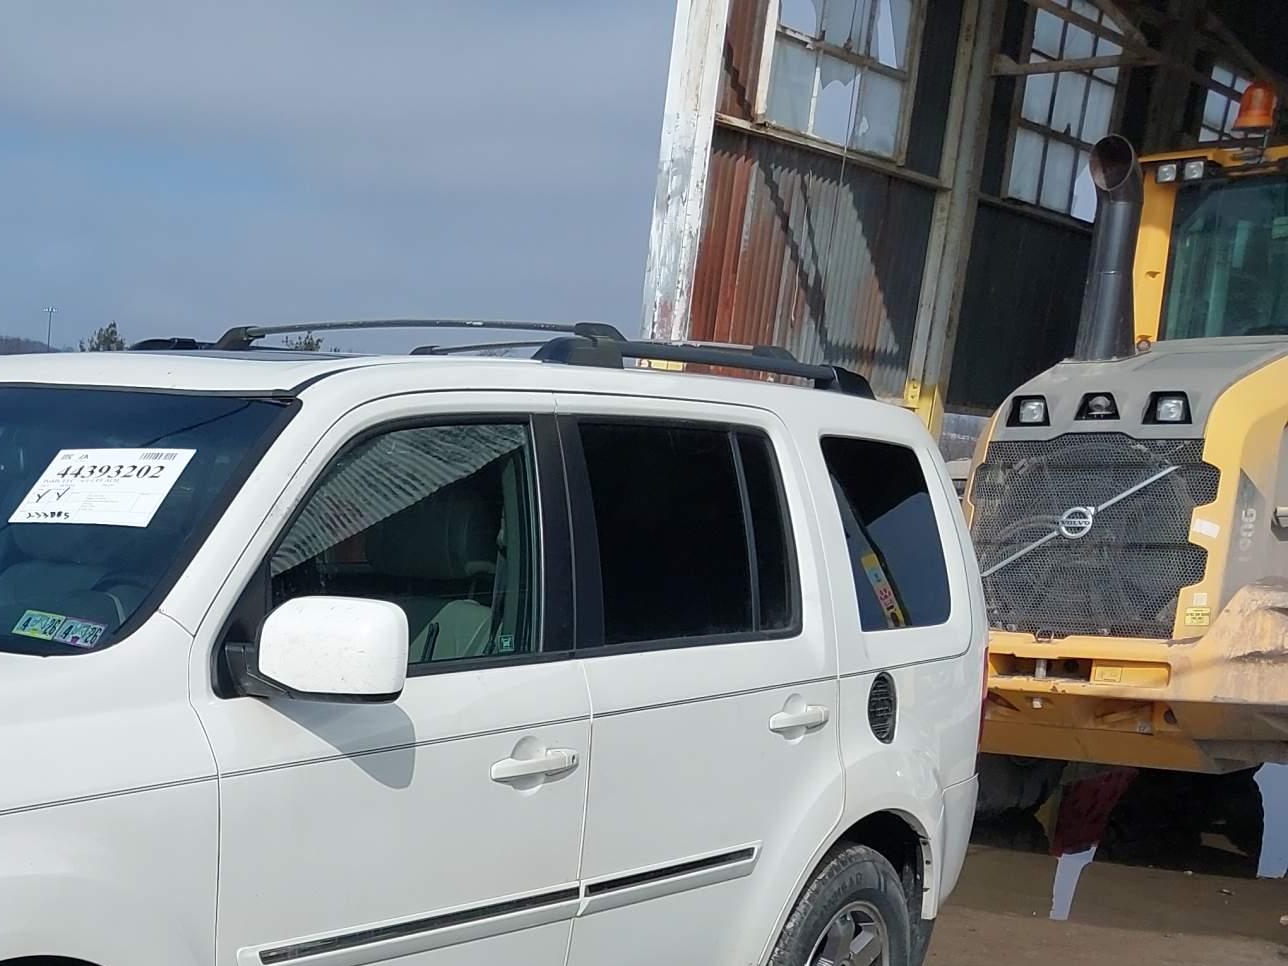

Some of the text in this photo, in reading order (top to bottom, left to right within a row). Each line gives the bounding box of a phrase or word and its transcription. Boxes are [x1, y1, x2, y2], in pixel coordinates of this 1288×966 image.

[56, 464, 166, 479] 44393202
[1061, 519, 1091, 528] VOLVO
[21, 616, 32, 631] 4
[61, 624, 73, 640] 4
